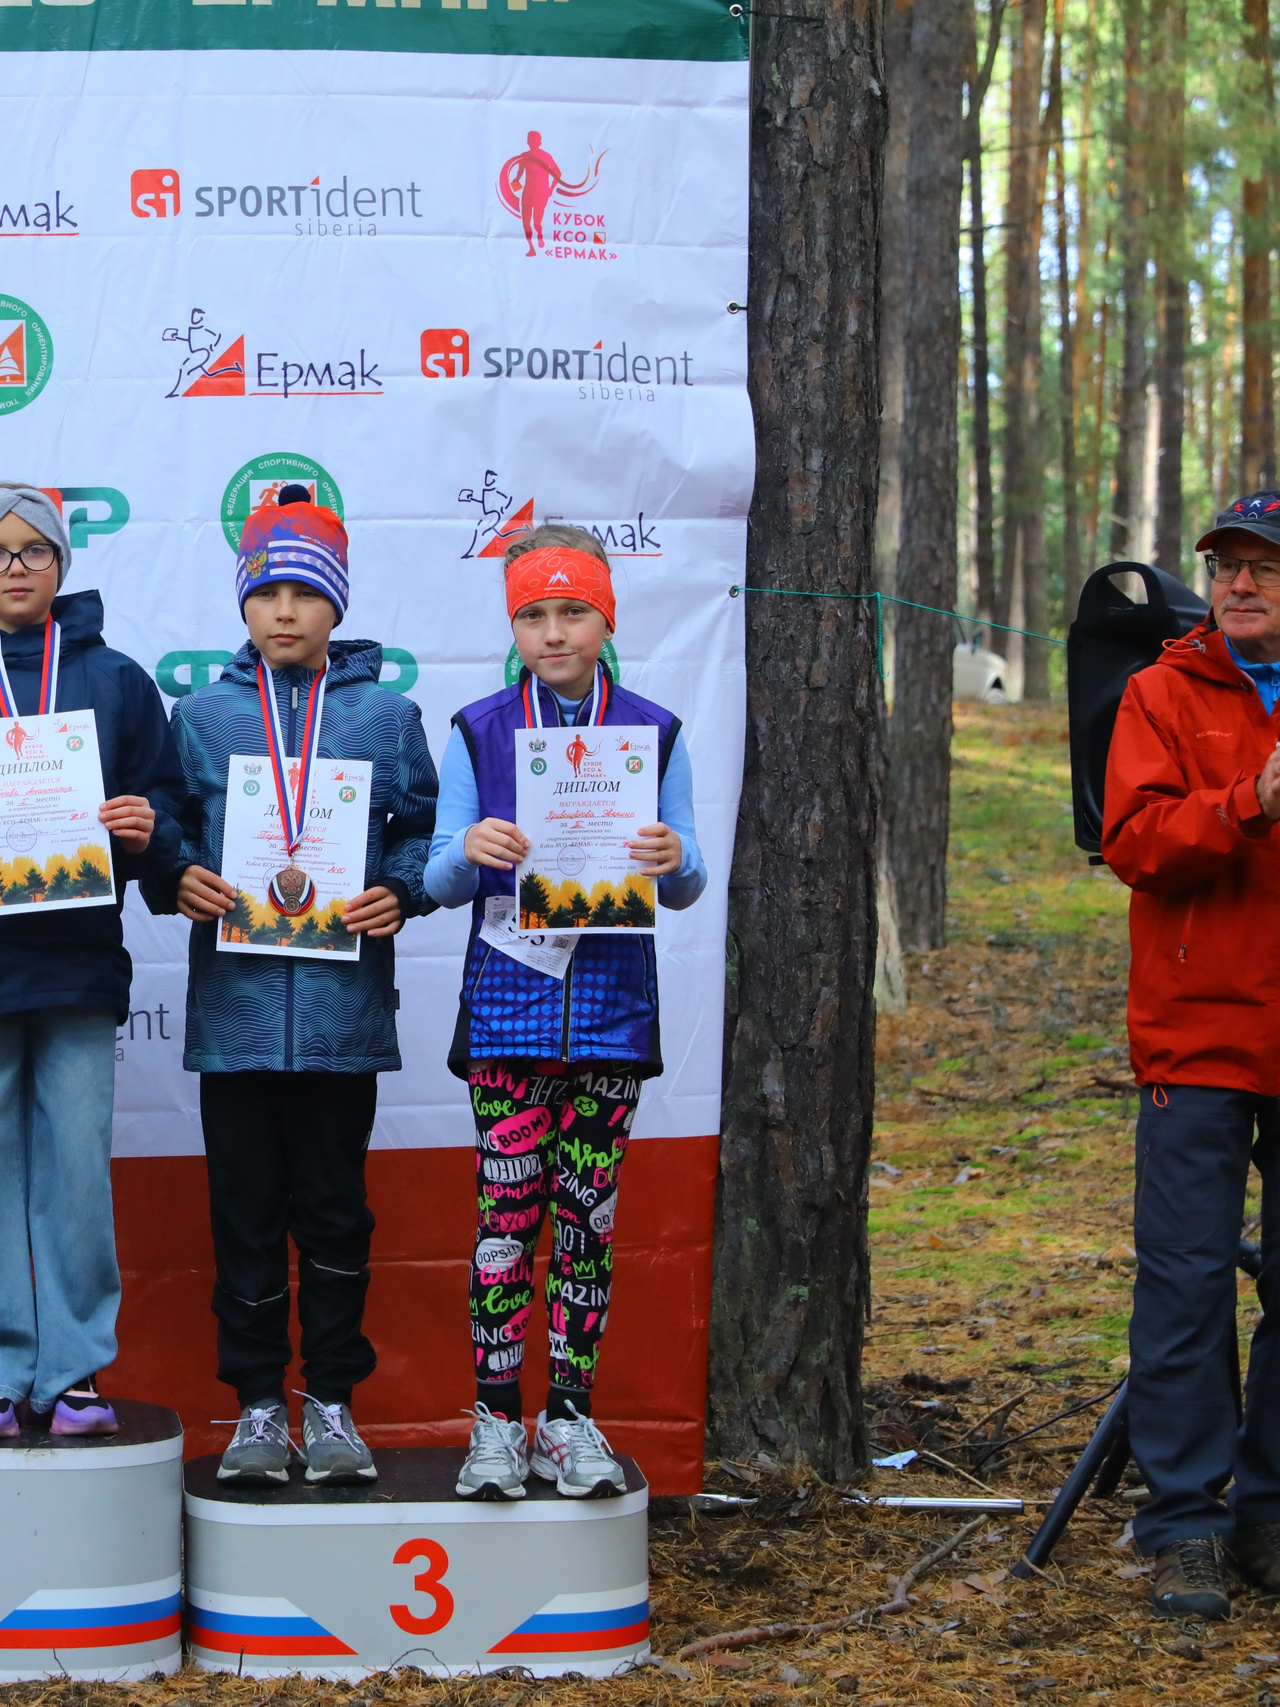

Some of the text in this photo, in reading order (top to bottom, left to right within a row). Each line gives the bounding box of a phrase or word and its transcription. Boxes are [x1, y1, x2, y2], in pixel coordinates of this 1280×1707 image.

[195, 175, 422, 218] SPORTident
[295, 219, 377, 236] siberia
[553, 213, 605, 227] КУБОК
[554, 230, 586, 242] КСО
[545, 247, 618, 260] «ЕРМАК»
[25, 322, 48, 397] ОРИЕНТИРОВАНИЯ
[484, 340, 694, 386] SPORTident
[257, 349, 383, 398] Ермак
[579, 383, 654, 401] siberia
[227, 459, 318, 515] ФЕДЕРАЦИЯ СПОРТИВНОГО
[630, 743, 651, 751] Ермак
[3, 777, 61, 787] НАГРАЖДАЕТСЯ
[345, 774, 365, 782] Ермак
[553, 781, 621, 796] ДИПЛОМ
[473, 1087, 516, 1116] love
[497, 1112, 547, 1148] BOOM!
[481, 1286, 531, 1314] love
[390, 1538, 454, 1635] 3
